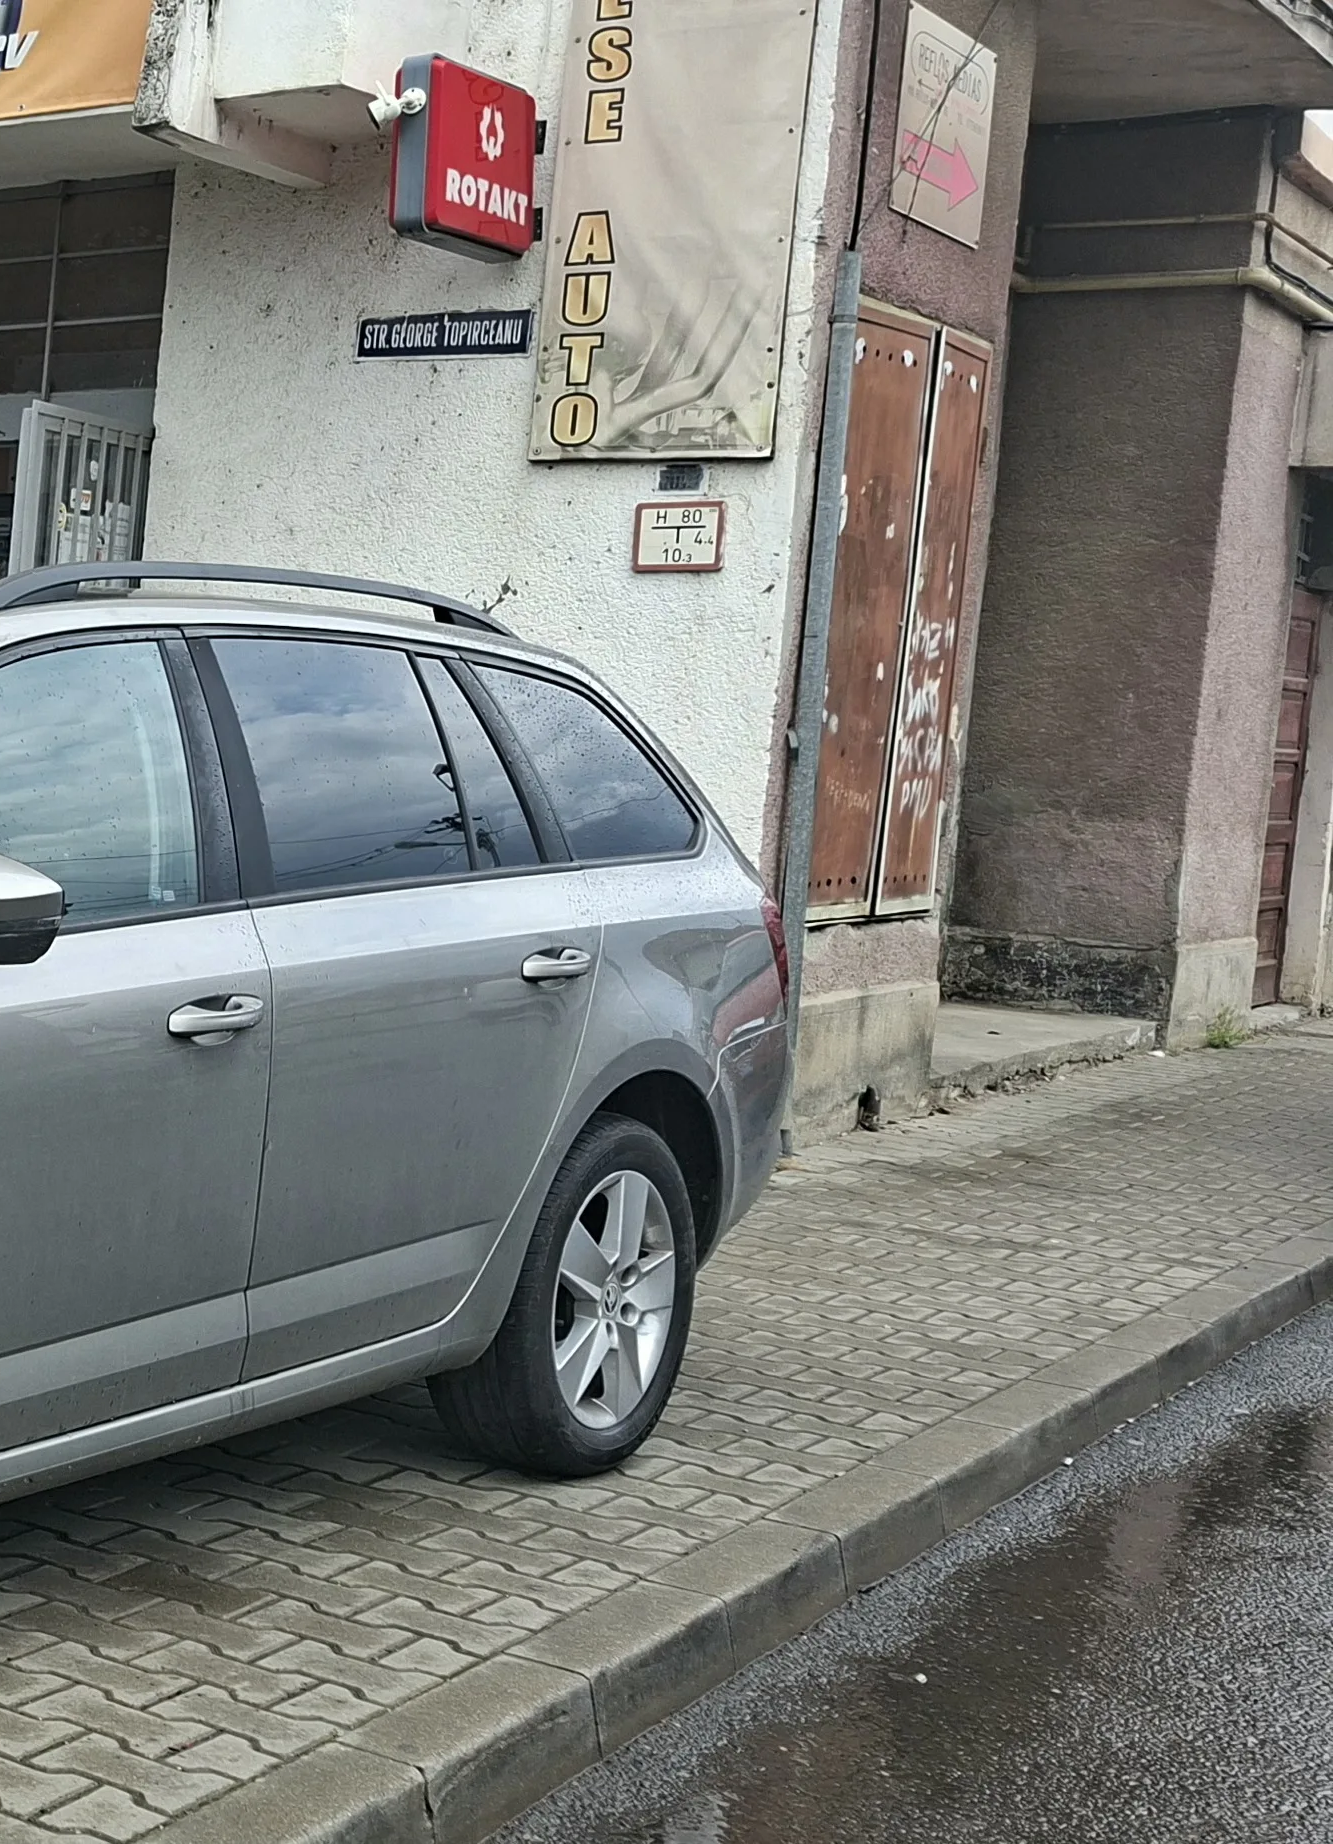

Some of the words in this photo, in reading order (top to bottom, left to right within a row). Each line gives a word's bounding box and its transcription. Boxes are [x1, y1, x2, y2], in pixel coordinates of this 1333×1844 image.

[445, 168, 528, 226] ROTAKT
[444, 318, 523, 347] TOPIRCEANU
[550, 209, 615, 447] AUTO
[656, 510, 667, 524] H
[681, 509, 702, 523] 80
